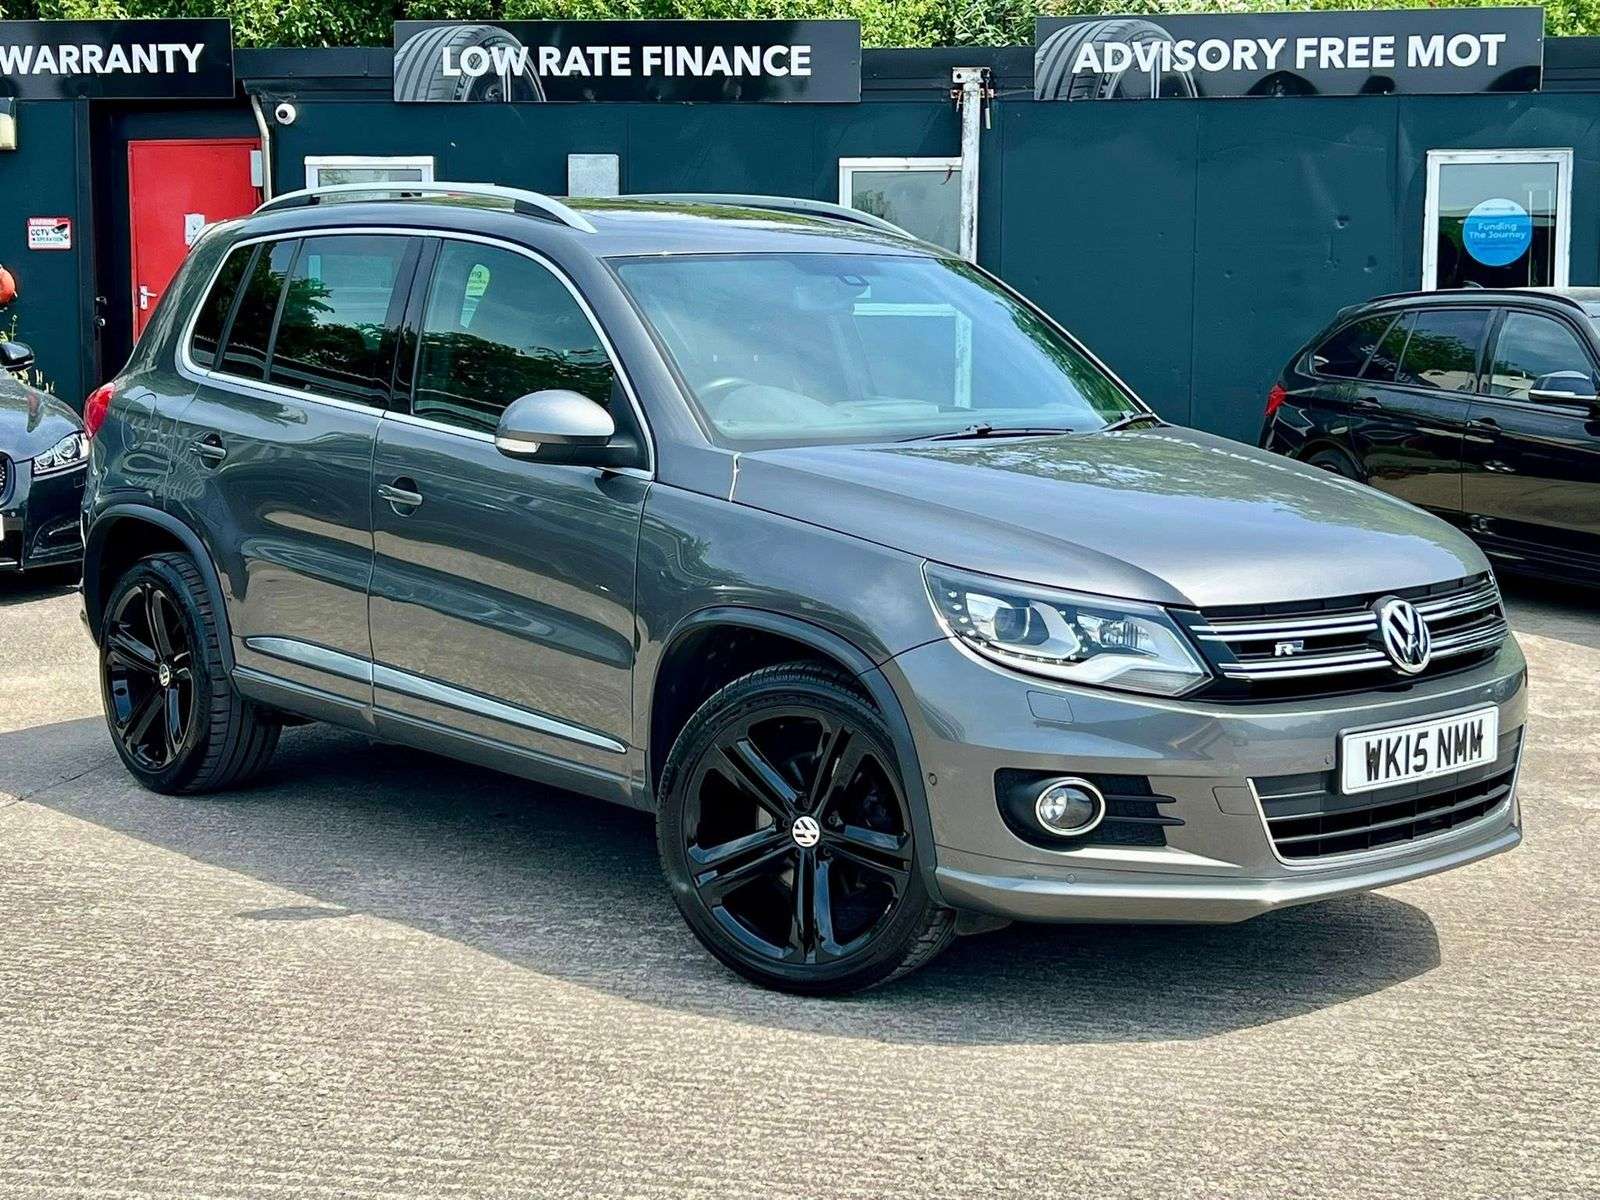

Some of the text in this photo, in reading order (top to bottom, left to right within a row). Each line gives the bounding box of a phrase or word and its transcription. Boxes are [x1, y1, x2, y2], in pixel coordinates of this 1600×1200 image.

[0, 44, 204, 75] WARRANTY
[442, 45, 811, 77] LOW RATE FINANCE
[1072, 34, 1506, 73] ADVISORY FREE MOT
[30, 228, 50, 236] CCTV
[1469, 231, 1486, 239] The
[1478, 223, 1517, 231] Funding
[1365, 719, 1484, 782] WK15 NMM
